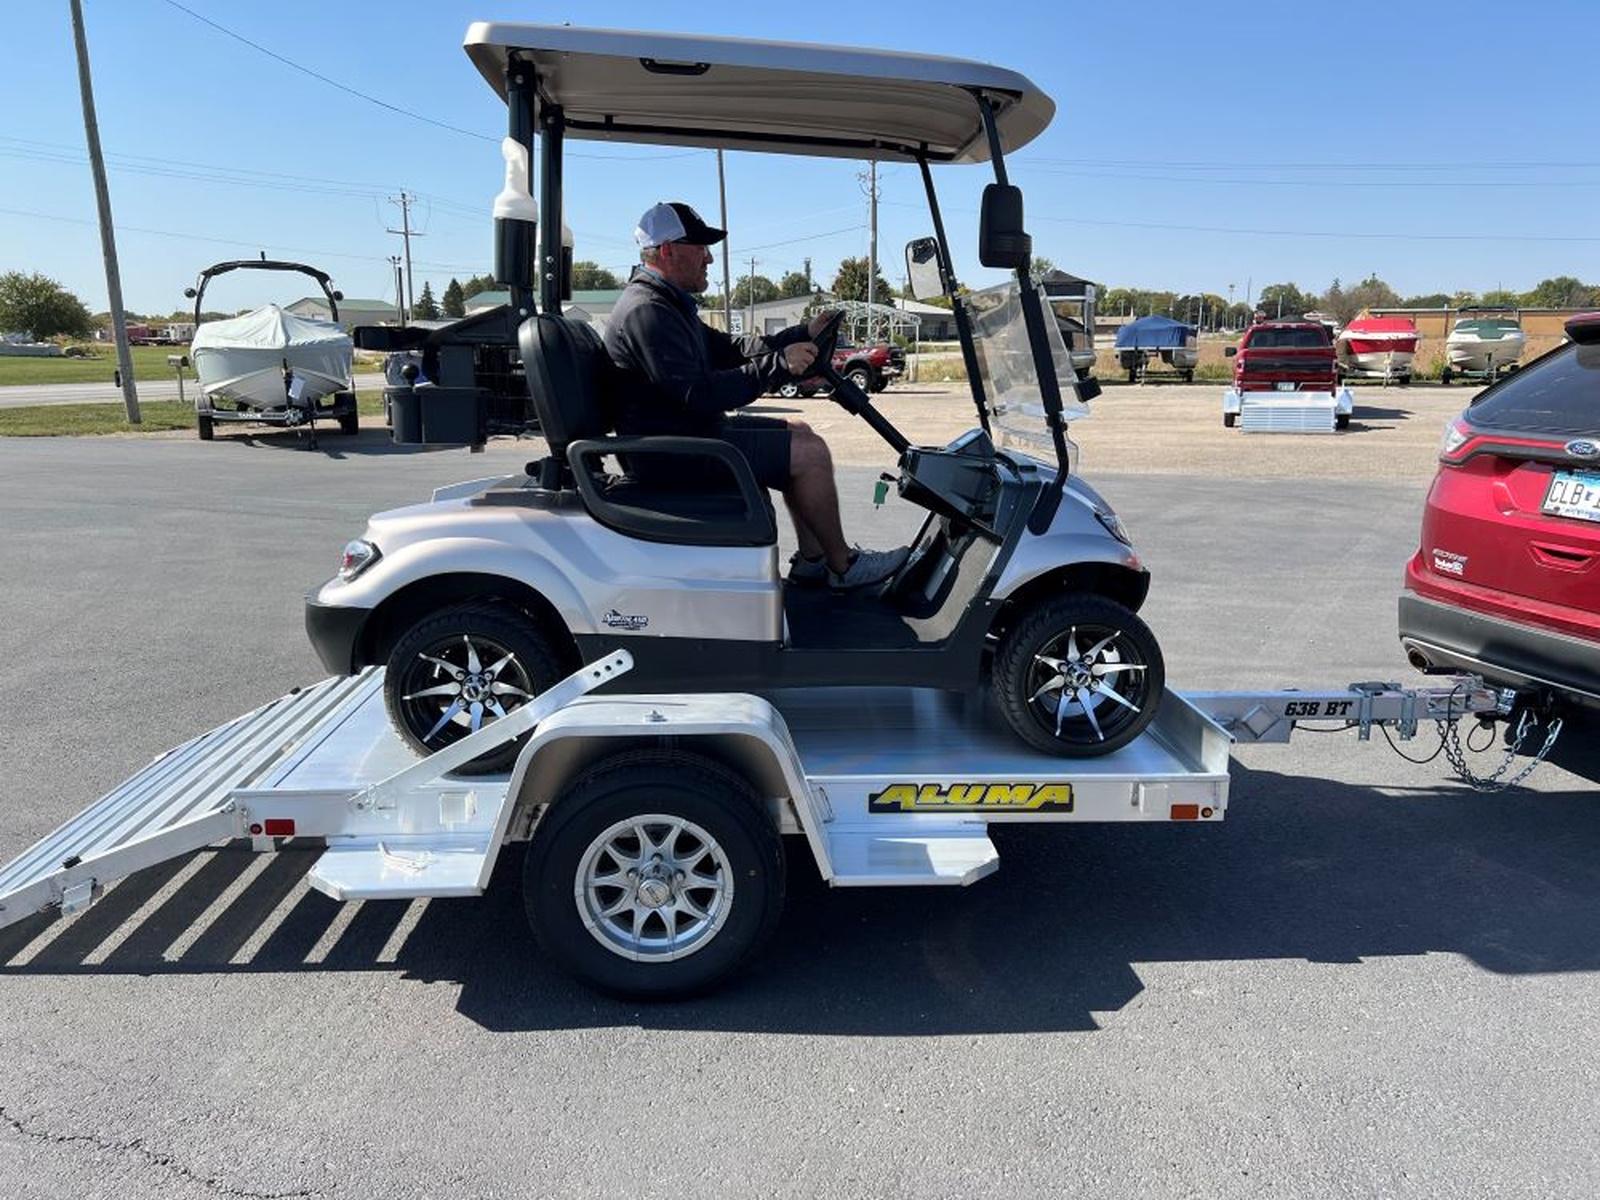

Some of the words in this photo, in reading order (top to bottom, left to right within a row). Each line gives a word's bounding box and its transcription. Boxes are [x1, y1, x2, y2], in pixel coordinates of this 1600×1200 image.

[1284, 702, 1320, 716] 638
[1324, 701, 1353, 716] BT
[873, 784, 1072, 810] ALUMA
